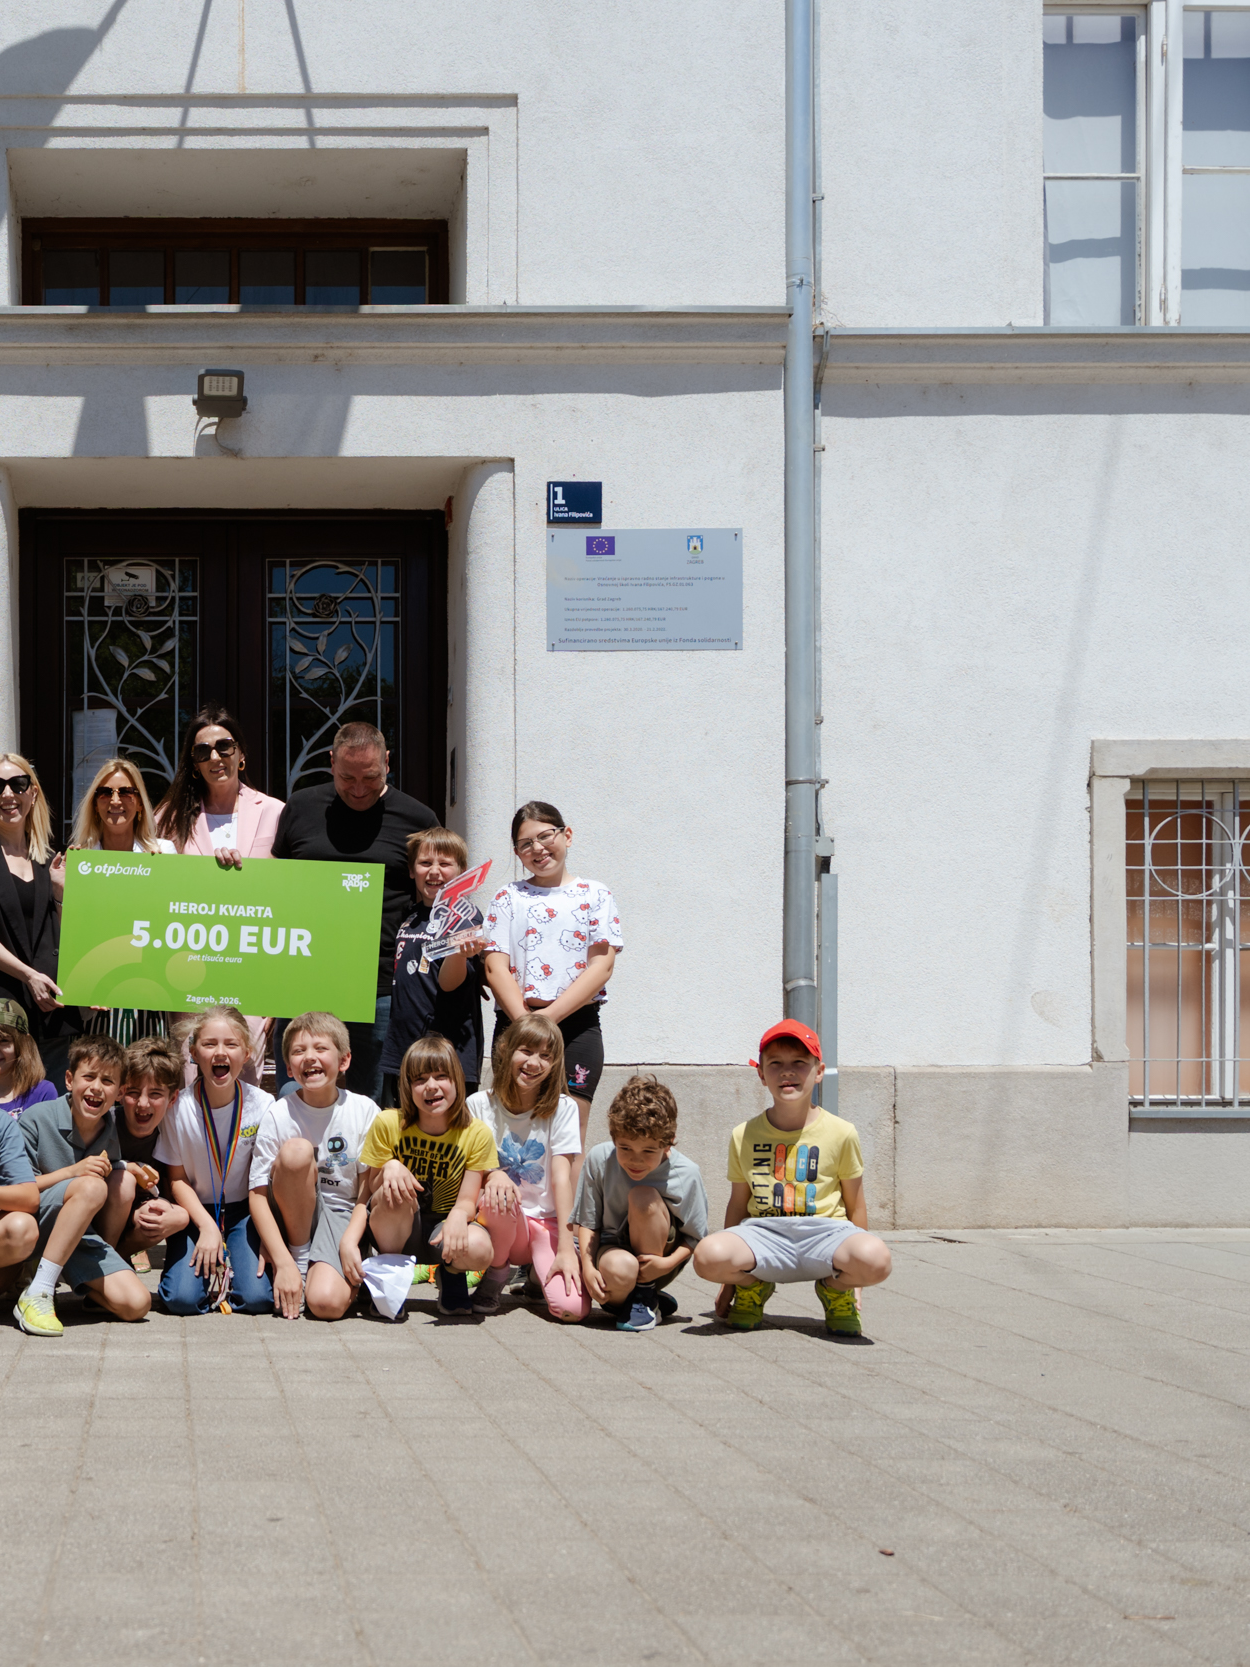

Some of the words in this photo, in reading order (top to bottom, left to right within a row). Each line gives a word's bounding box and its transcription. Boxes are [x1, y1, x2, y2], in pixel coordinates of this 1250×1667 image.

[554, 486, 566, 505] 1
[568, 511, 594, 519] Filipovića
[94, 862, 152, 877] otpbanka
[342, 872, 364, 881] TOP
[342, 880, 370, 892] RADIO
[169, 902, 216, 915] HEROJ
[218, 904, 273, 918] KVARTA
[130, 920, 230, 952] 5.000
[239, 925, 312, 956] EUR
[187, 954, 201, 962] pet
[202, 954, 224, 962] tisuća
[186, 994, 218, 1006] Zagreb,
[219, 996, 242, 1006] 2026.
[402, 1155, 450, 1180] TIGER
